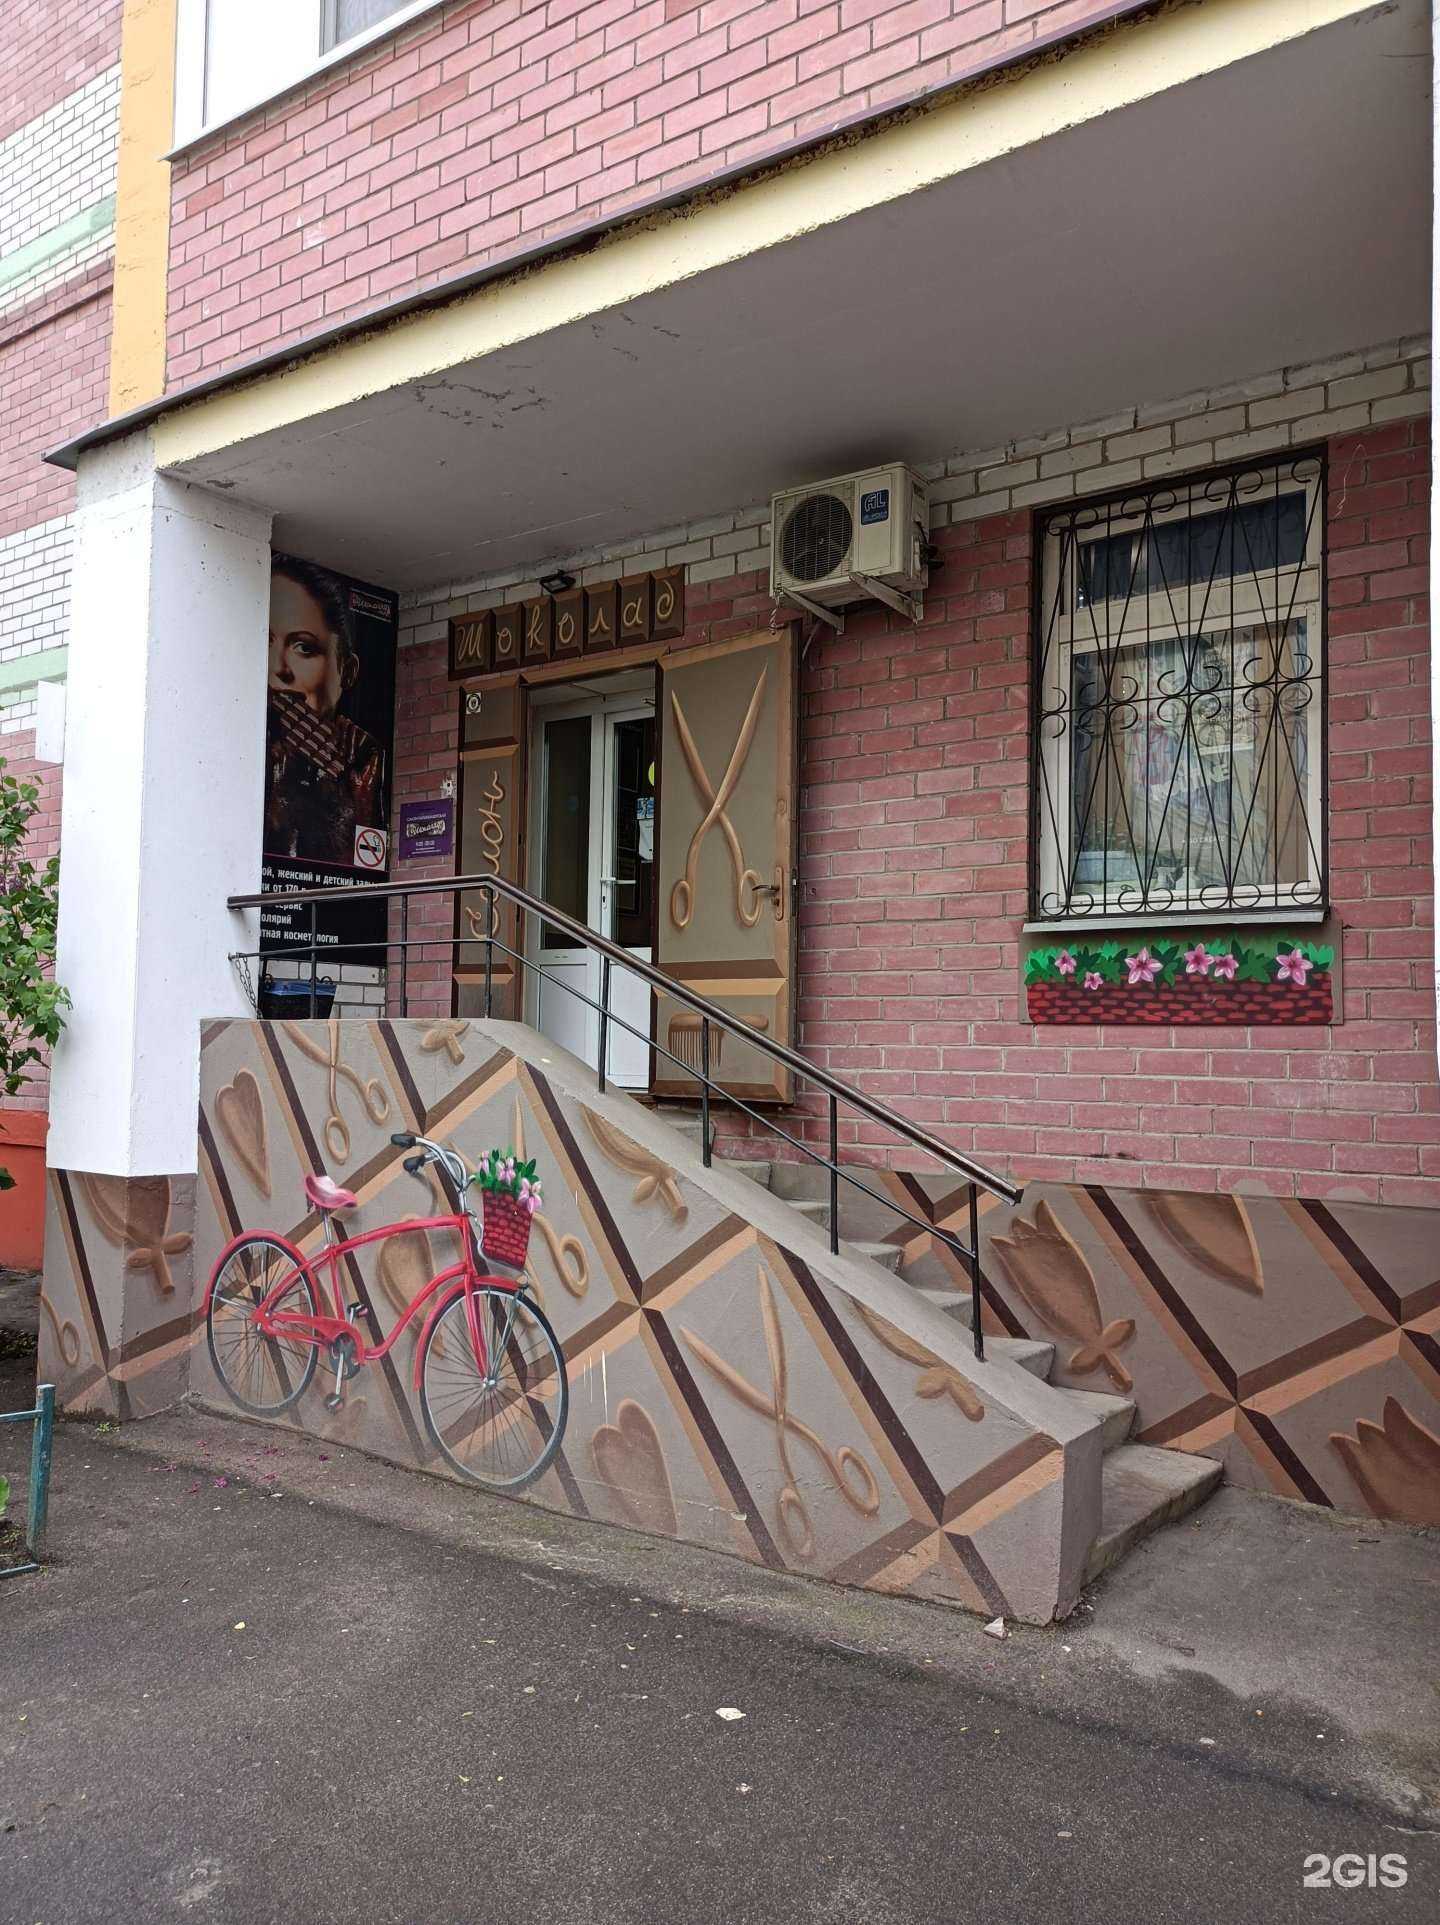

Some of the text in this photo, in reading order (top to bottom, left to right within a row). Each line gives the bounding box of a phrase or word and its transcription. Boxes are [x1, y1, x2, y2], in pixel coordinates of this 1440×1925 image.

[457, 579, 674, 661] Шоколад
[262, 866, 275, 878] ой,
[277, 869, 313, 882] женский
[315, 874, 321, 883] и
[322, 875, 354, 886] детский
[273, 884, 283, 892] от
[261, 913, 292, 925] олярий
[261, 928, 339, 944] тная косметлогия
